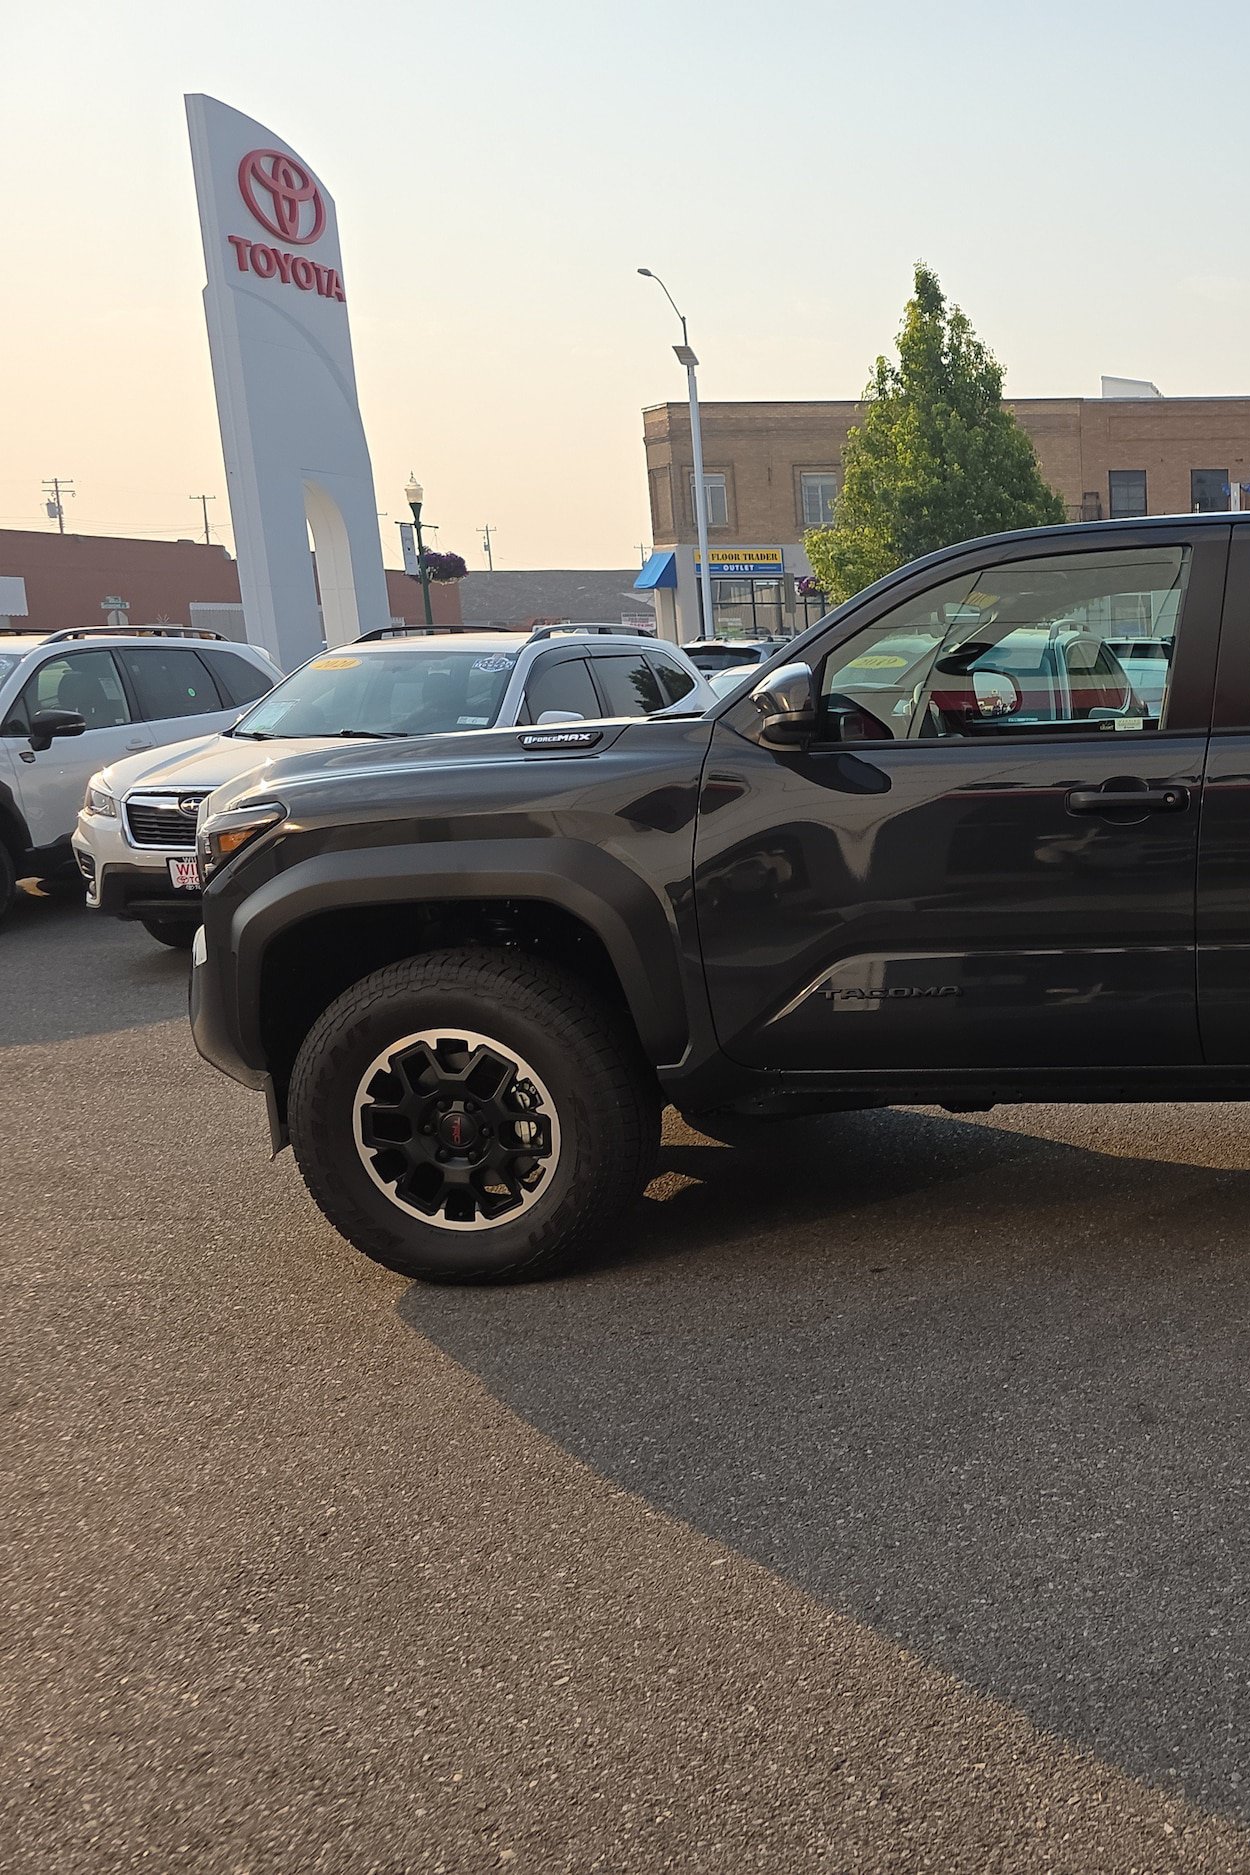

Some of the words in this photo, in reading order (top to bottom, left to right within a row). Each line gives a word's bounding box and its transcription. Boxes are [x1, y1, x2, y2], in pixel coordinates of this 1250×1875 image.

[227, 234, 346, 302] TOYOTA
[711, 553, 741, 561] FLOOR
[742, 553, 778, 561] TRADER
[817, 984, 963, 1000] TACOMA
